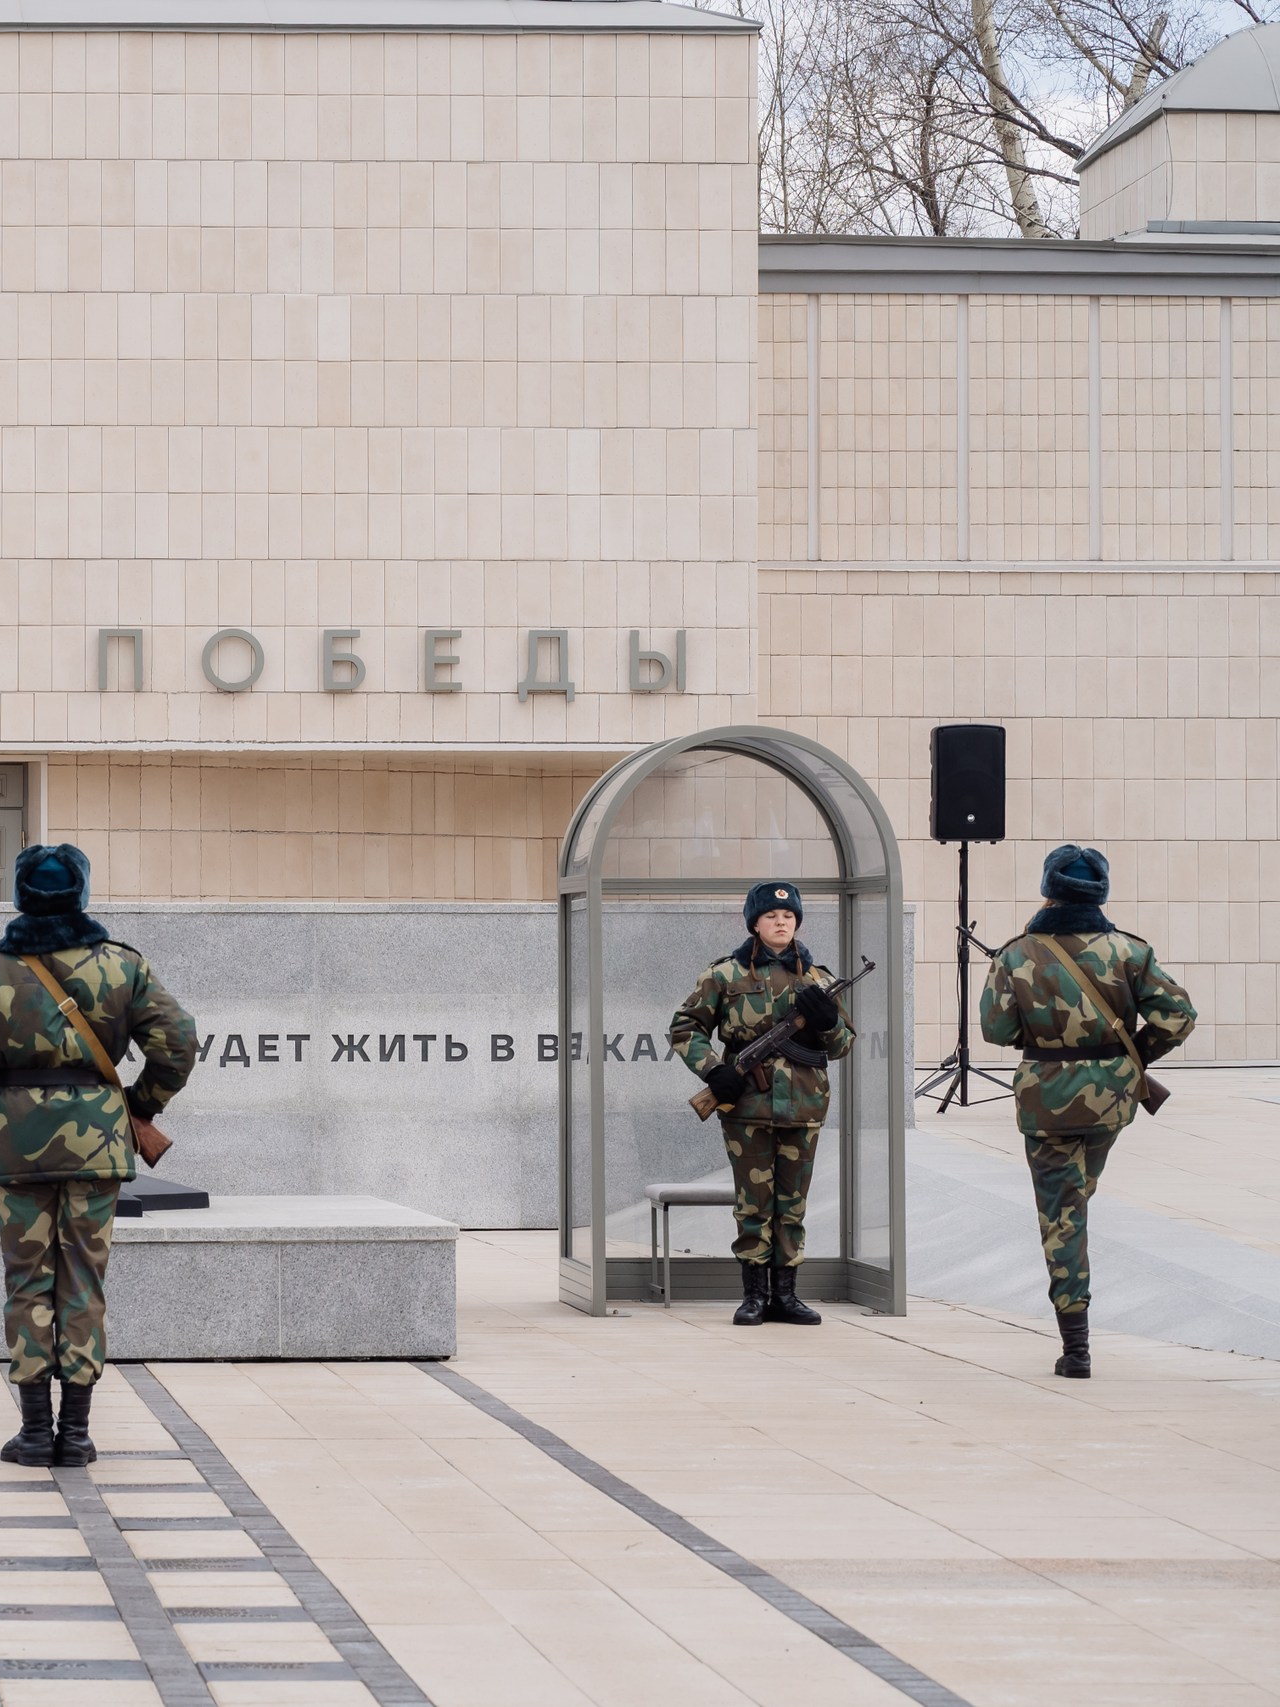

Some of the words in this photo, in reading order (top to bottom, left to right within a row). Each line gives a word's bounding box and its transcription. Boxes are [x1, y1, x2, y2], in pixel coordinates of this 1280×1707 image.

[97, 628, 688, 702] ПОБЕДЫ
[195, 1034, 311, 1068] УДЕТ
[330, 1034, 469, 1062] ЖИТЬ
[490, 1034, 515, 1062] В
